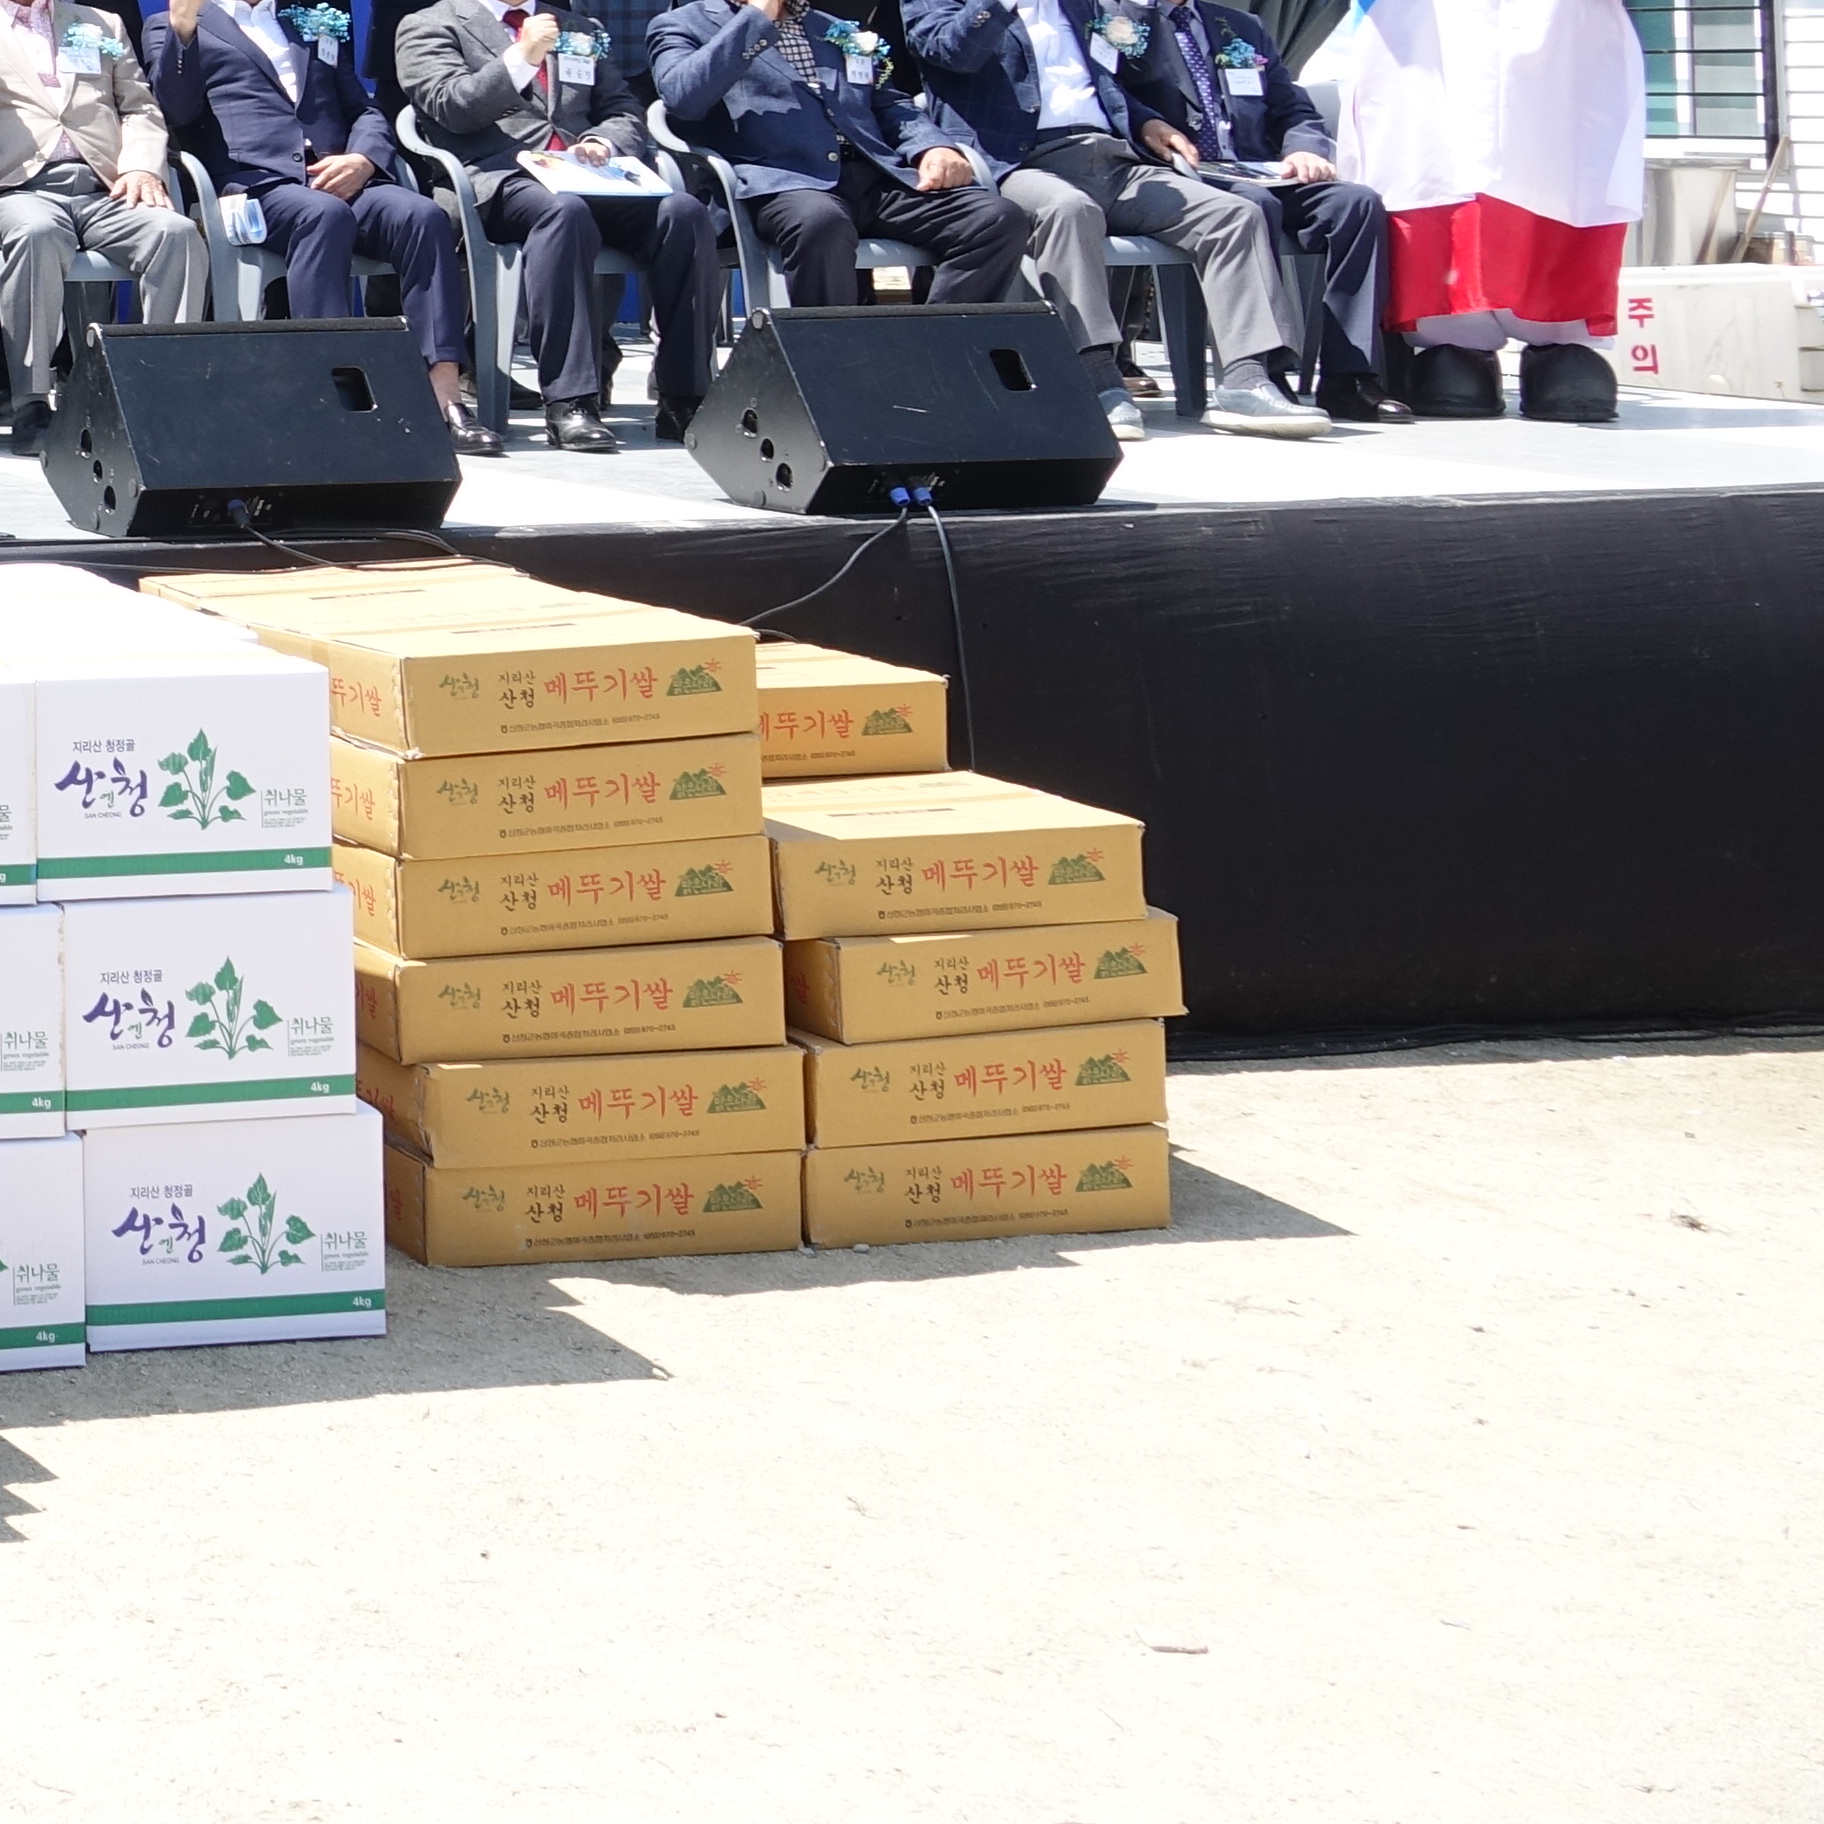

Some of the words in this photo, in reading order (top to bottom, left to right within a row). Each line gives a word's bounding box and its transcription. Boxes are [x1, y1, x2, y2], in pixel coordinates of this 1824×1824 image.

[1628, 298, 1659, 374] 주의
[498, 670, 535, 686] 지리산
[544, 666, 658, 704] 메뚜기쌀
[499, 687, 535, 710] 산청
[73, 740, 102, 753] 지리산
[106, 739, 135, 752] 청정골
[498, 775, 536, 790] 지리산
[545, 771, 661, 810] 메뚜기쌀
[264, 788, 307, 806] 취나물
[498, 793, 535, 815] 산청
[284, 854, 303, 865] 4kg
[876, 857, 913, 871] 지리산
[501, 873, 538, 888] 지리산
[922, 856, 1038, 893] 메뚜기쌀
[548, 869, 666, 907] 메뚜기쌀
[876, 874, 913, 895] 산청
[501, 890, 538, 912] 산청
[935, 956, 970, 970] 지리산
[977, 951, 1085, 991] 메뚜기쌀
[100, 972, 130, 984] 지리산
[134, 970, 162, 983] 청정골
[934, 974, 968, 996] 산청
[503, 979, 541, 994] 지리산
[551, 978, 672, 1015] 메뚜기쌀
[502, 996, 540, 1020] 산청
[291, 1017, 333, 1035] 취나물
[4, 1032, 48, 1050] 취나물
[910, 1062, 945, 1076] 지리산
[954, 1059, 1067, 1097] 메뚜기쌀
[310, 1081, 330, 1093] 4kg
[531, 1085, 570, 1100] 지리산
[909, 1080, 945, 1101] 산청
[32, 1097, 51, 1108] 4kg
[578, 1084, 698, 1122] 메뚜기쌀
[531, 1103, 568, 1125] 산청
[905, 1166, 942, 1179] 지리산
[952, 1163, 1067, 1200] 메뚜기쌀
[130, 1186, 160, 1198] 지리산
[164, 1184, 193, 1198] 청정골
[526, 1184, 565, 1199] 지리산
[904, 1182, 941, 1204] 산청
[574, 1182, 695, 1219] 메뚜기쌀
[525, 1201, 563, 1224] 산청
[324, 1232, 367, 1250] 취나물
[17, 1264, 60, 1283] 취나물
[352, 1296, 371, 1308] 4kg
[36, 1330, 55, 1343] 4kg
